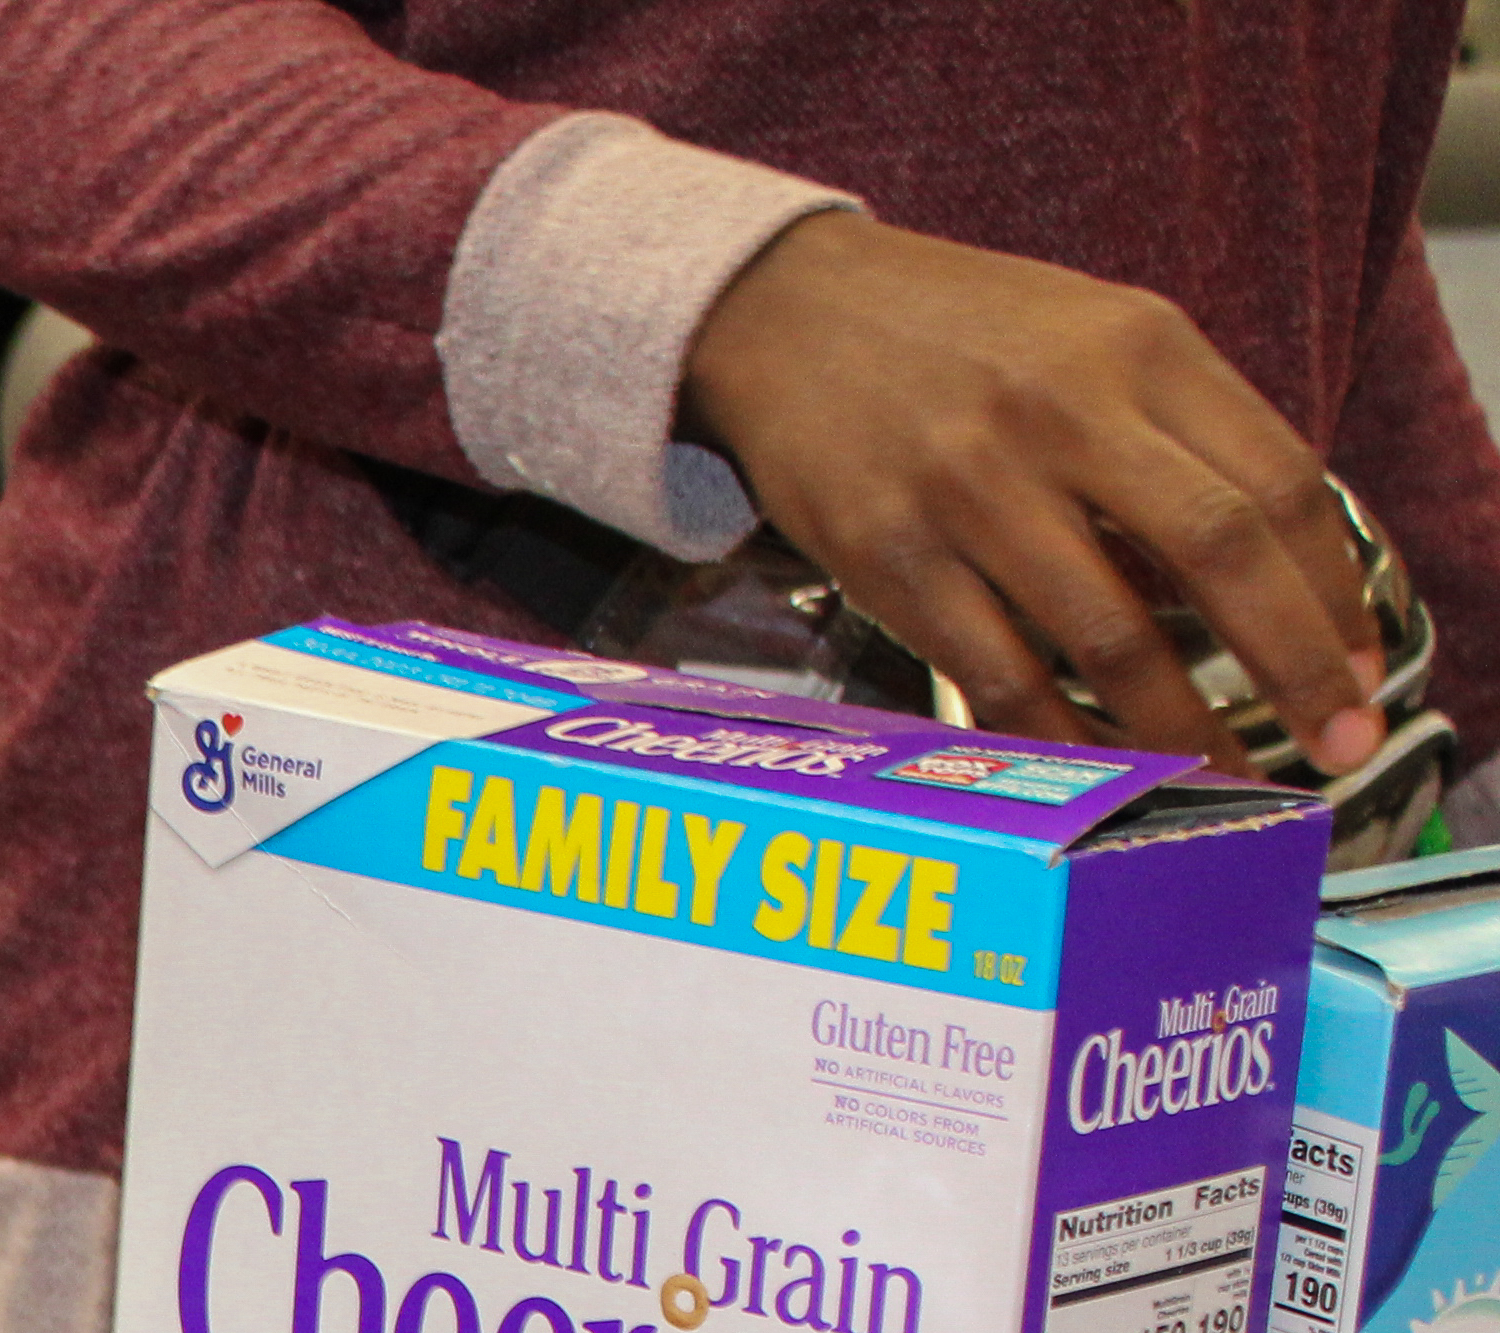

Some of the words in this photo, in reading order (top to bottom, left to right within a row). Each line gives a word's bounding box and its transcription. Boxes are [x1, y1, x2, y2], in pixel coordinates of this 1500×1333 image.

[241, 744, 323, 781] General
[544, 715, 847, 778] Cheerios
[240, 770, 287, 799] Mills
[421, 764, 747, 928] FAMILY
[752, 830, 960, 973] SIZE
[973, 950, 997, 980] 18
[999, 954, 1028, 987] OZ
[1158, 991, 1216, 1039] Multi
[1223, 980, 1278, 1025] Grain
[811, 998, 931, 1066] Gluten
[942, 1023, 1017, 1082] Free
[813, 1057, 840, 1078] NO
[844, 1063, 928, 1095] ARTIFICIAL
[933, 1080, 1005, 1110] FLAVORS
[1068, 1021, 1274, 1134] Cheerios
[825, 1113, 909, 1146] ARTIFICIAL
[913, 1128, 987, 1156] SOURCES
[834, 1094, 861, 1112] NO
[864, 1101, 922, 1126] COLORS
[926, 1115, 980, 1136] FROM
[1290, 1131, 1356, 1177] acts
[432, 1136, 652, 1290] Multi
[1058, 1199, 1173, 1243] Nutrition
[1194, 1176, 1260, 1210] Facts
[1314, 1198, 1349, 1223] (39g)
[1200, 1237, 1223, 1259] cup
[1052, 1264, 1102, 1289] Serving
[1105, 1259, 1130, 1278] size
[1285, 1271, 1338, 1314] 190
